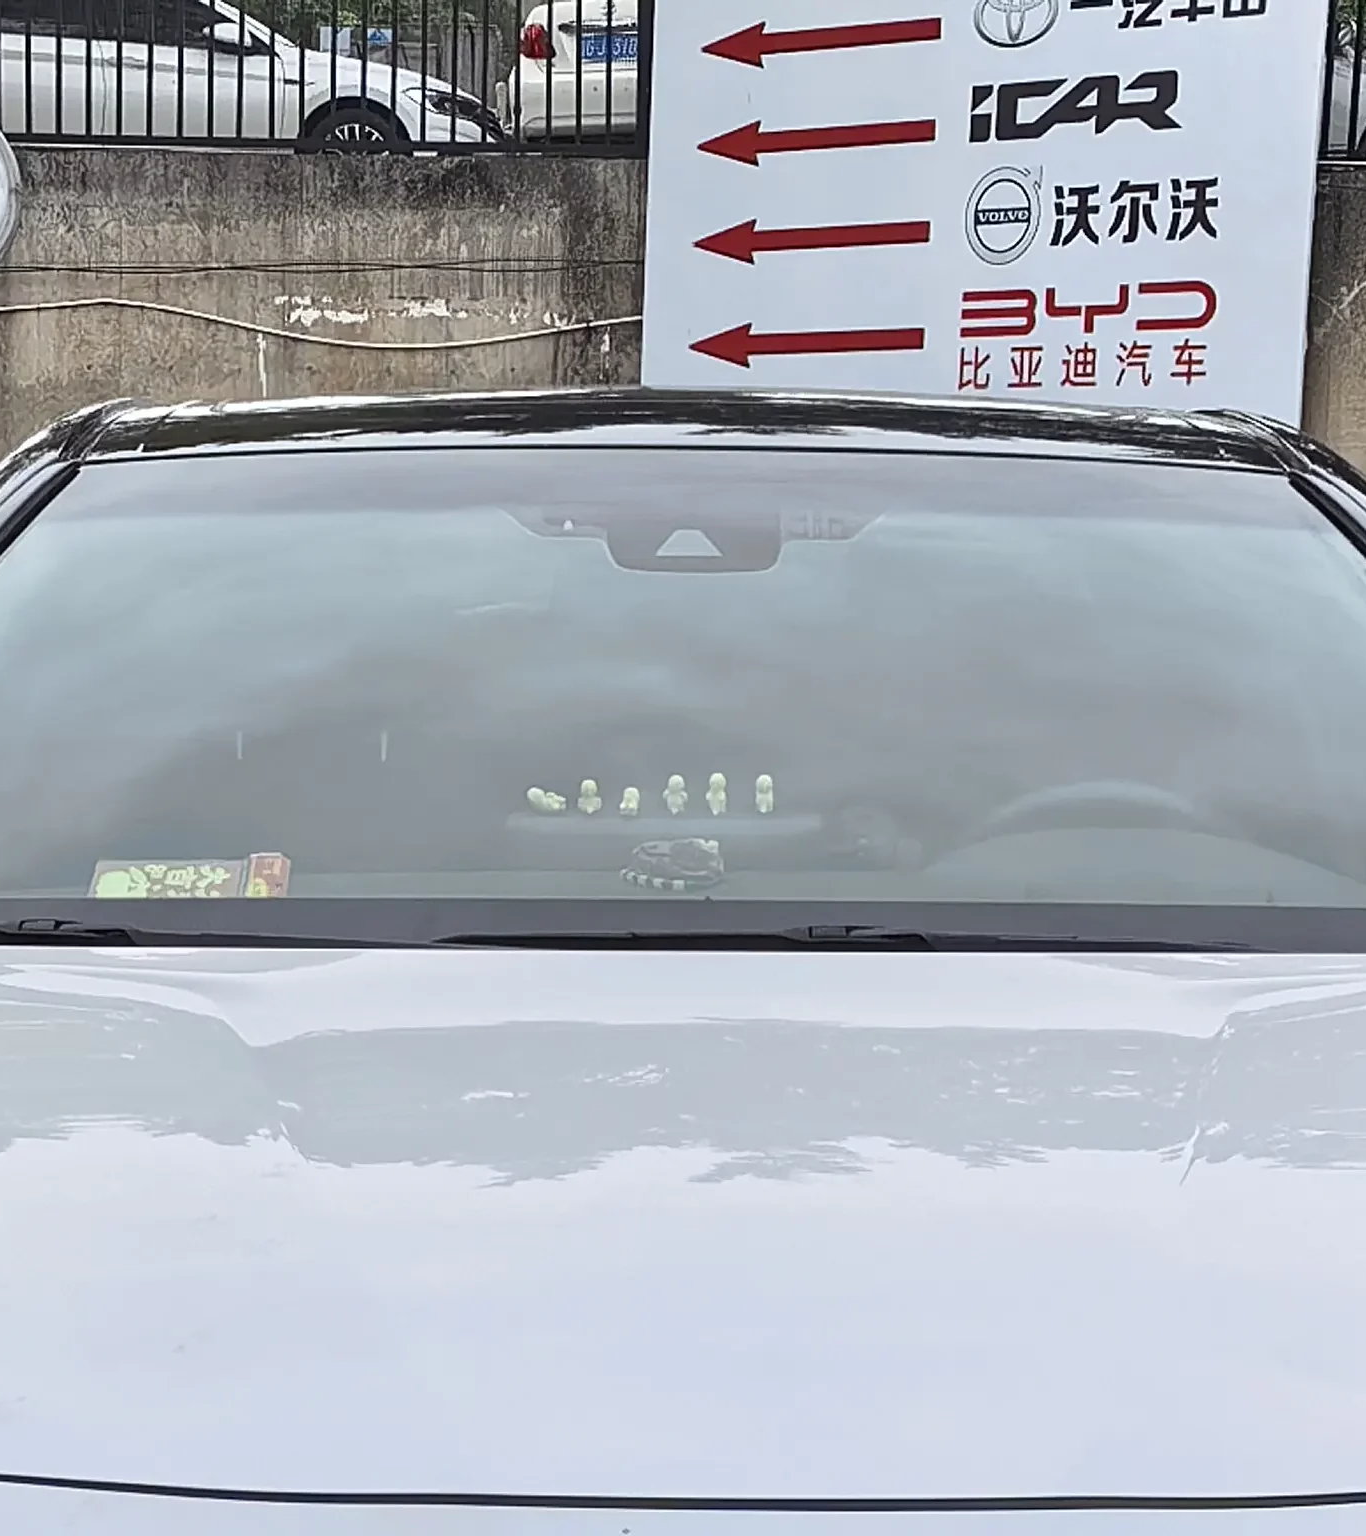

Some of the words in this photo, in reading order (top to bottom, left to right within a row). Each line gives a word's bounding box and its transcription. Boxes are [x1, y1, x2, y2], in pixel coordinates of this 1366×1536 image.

[977, 210, 1029, 223] VOLVO
[1049, 176, 1220, 247] 沃尔沃
[959, 280, 1217, 338] BYD
[957, 340, 1209, 390] 比亚迪汽车
